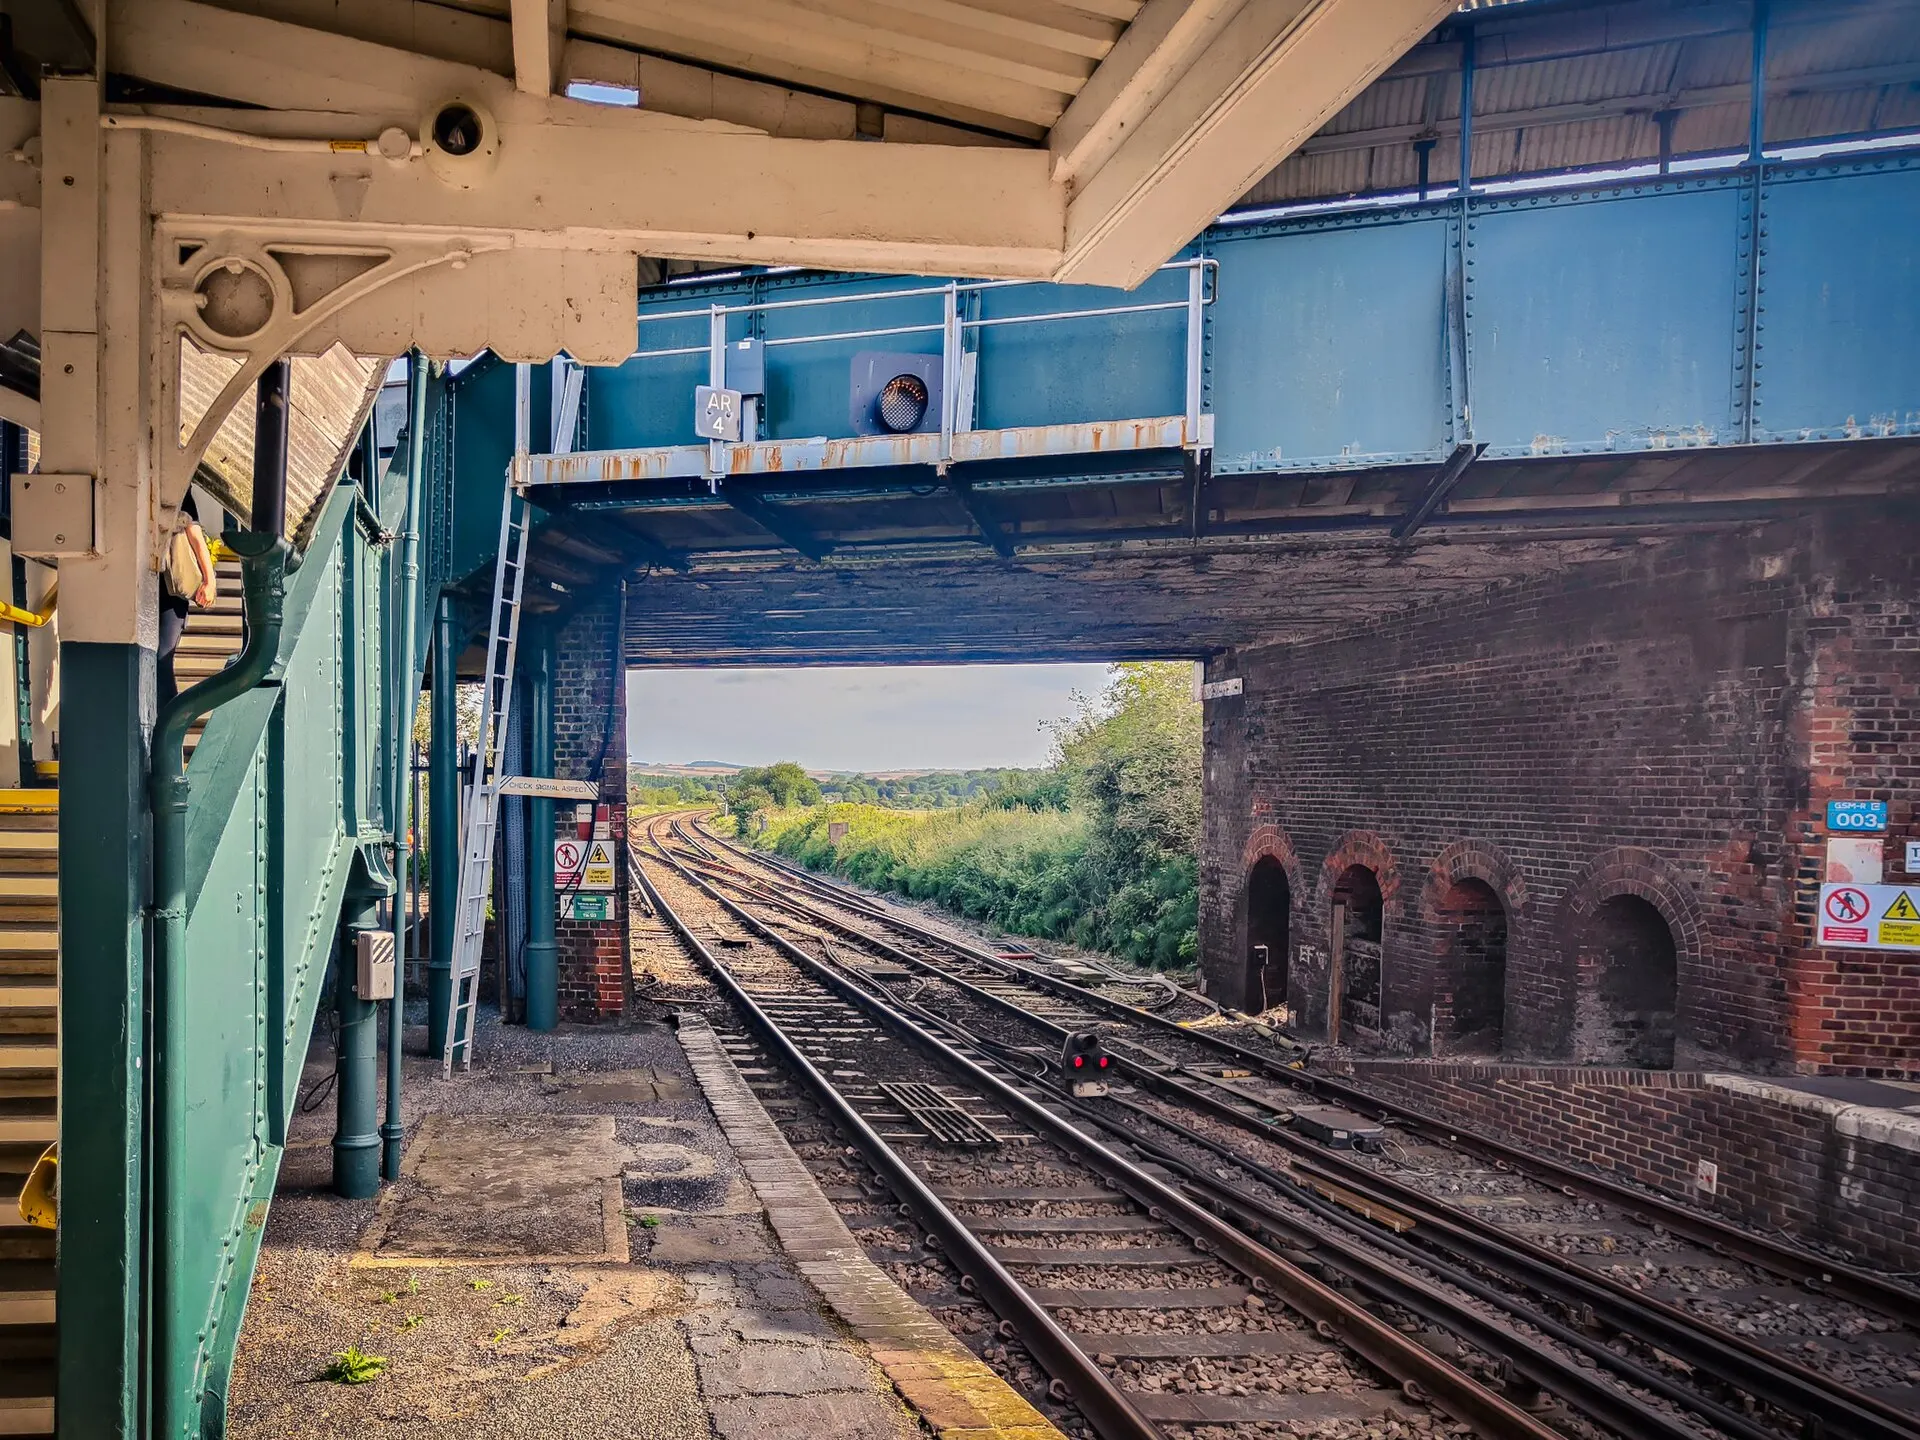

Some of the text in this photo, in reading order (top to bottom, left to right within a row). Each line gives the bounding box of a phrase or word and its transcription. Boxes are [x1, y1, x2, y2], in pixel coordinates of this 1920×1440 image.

[708, 392, 731, 412] AR
[712, 416, 725, 434] 4
[508, 782, 587, 793] CHECK SIGNAL ASPECT
[1834, 801, 1867, 810] GSM-R
[1836, 812, 1878, 828] 003
[1883, 923, 1913, 931] Danger
